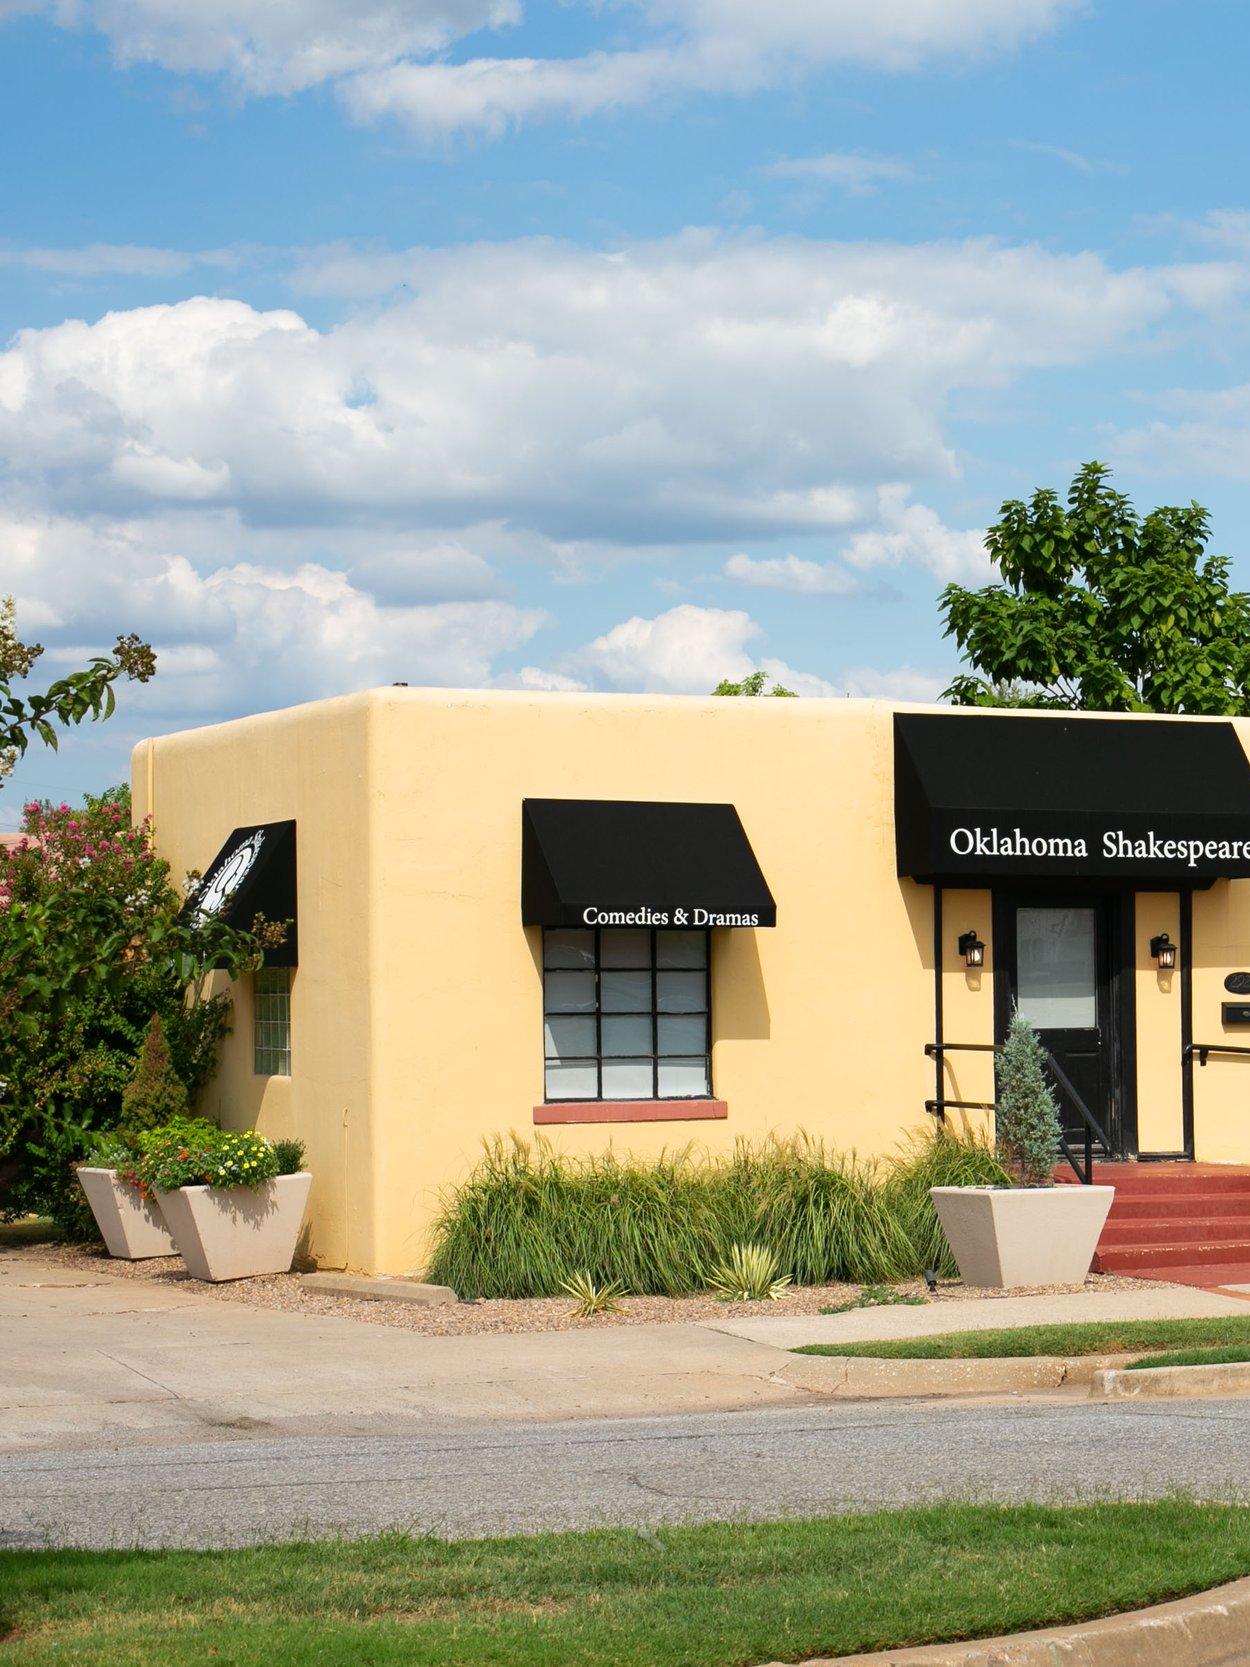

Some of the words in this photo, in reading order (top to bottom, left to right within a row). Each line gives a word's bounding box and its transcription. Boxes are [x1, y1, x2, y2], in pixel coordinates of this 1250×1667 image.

[950, 828, 1088, 857] Oklahoma
[583, 907, 669, 925] Comedies
[673, 908, 689, 925] &
[693, 908, 759, 926] Dramas
